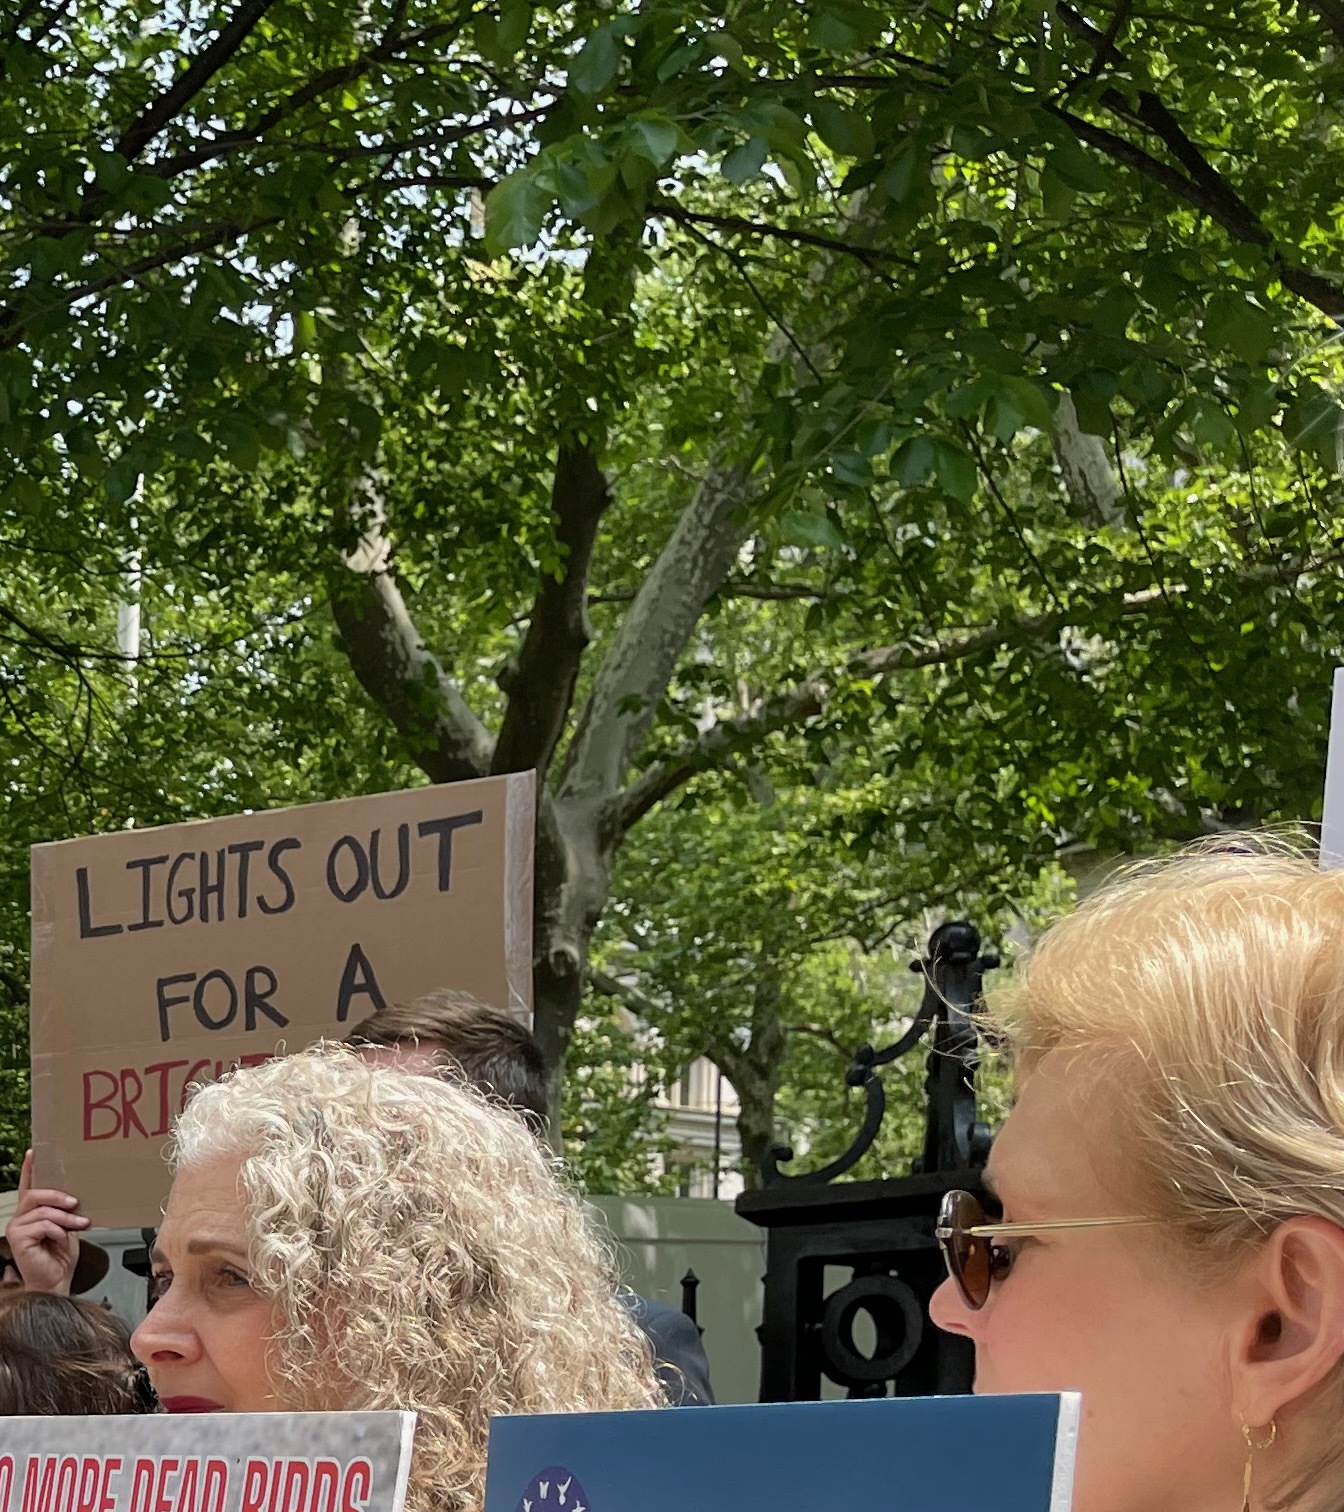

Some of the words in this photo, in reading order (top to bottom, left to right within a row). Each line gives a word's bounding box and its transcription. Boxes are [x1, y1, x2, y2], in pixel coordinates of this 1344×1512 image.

[76, 838, 302, 938] LIGHTS
[327, 810, 483, 902] OUT
[156, 965, 290, 1042] FOR
[336, 943, 387, 1022] A
